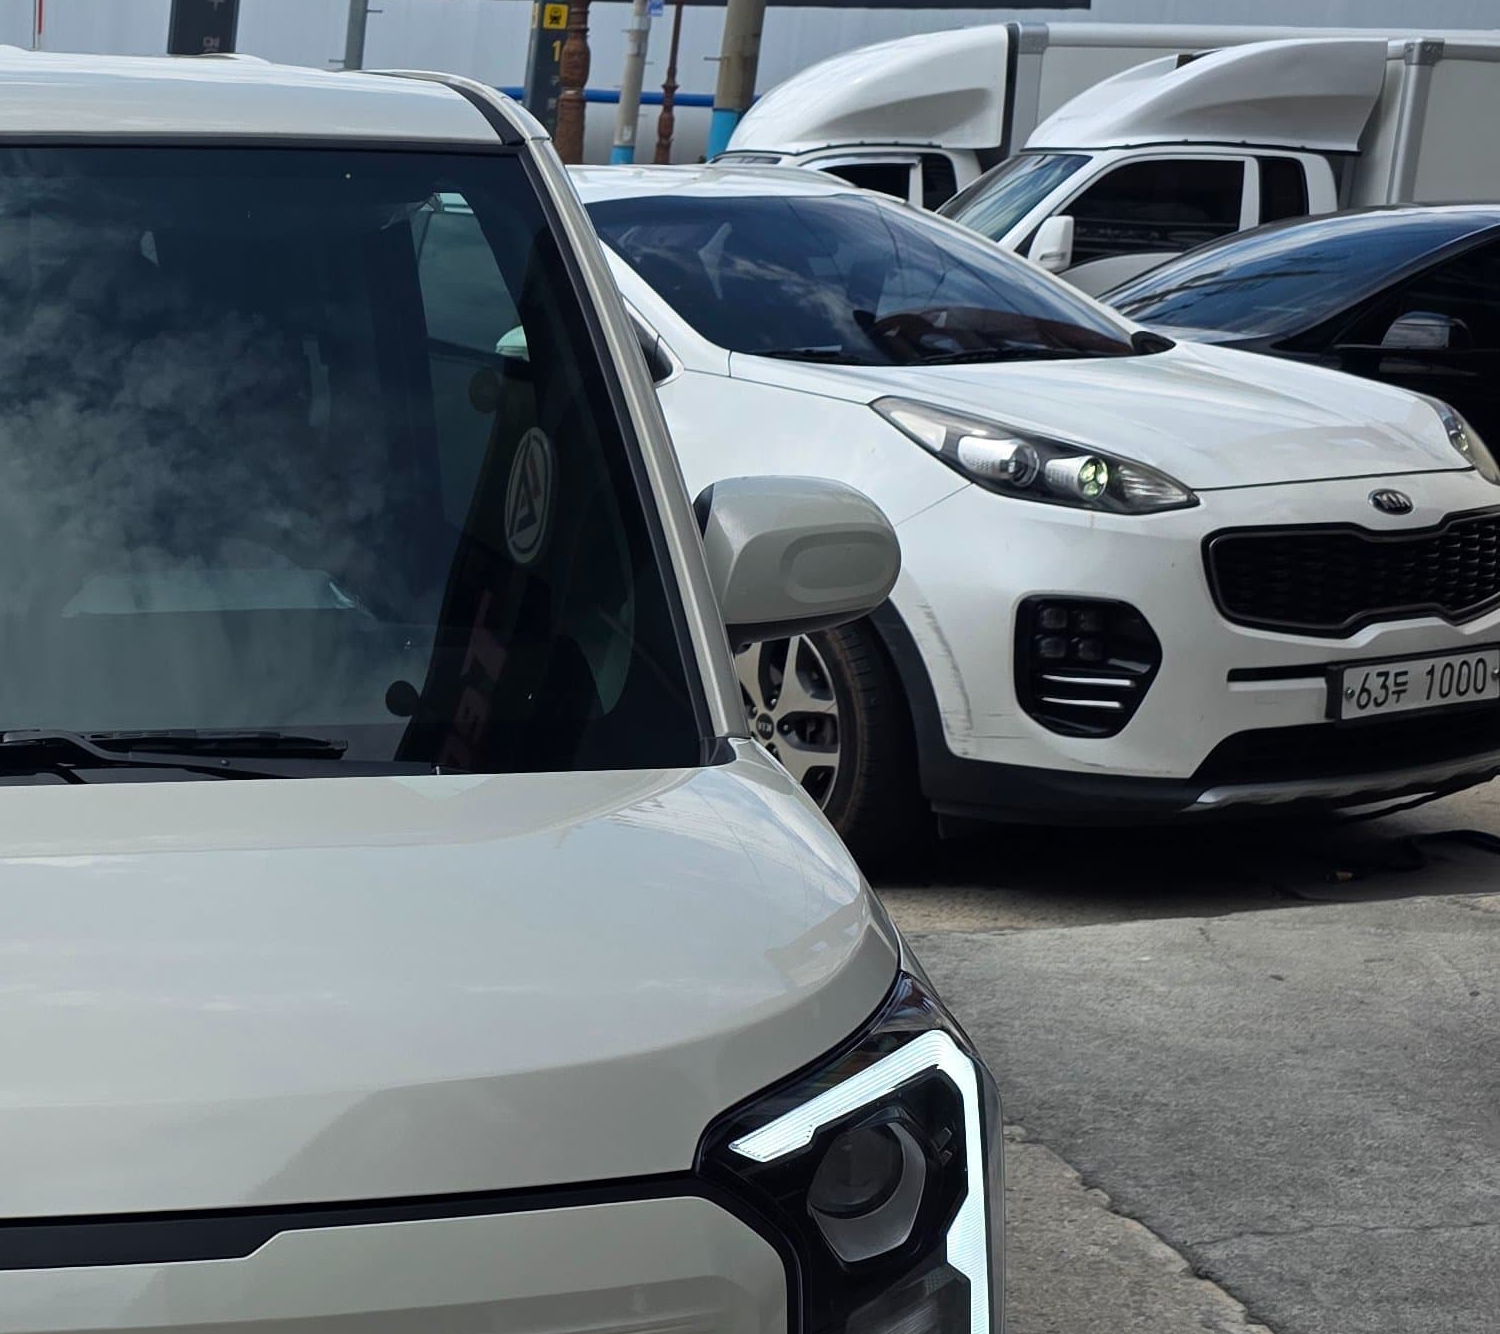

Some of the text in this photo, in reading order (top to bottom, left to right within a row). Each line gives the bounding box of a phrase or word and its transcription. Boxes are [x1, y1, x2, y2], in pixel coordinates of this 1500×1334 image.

[552, 40, 562, 63] 1
[1356, 657, 1488, 711] 63두 1000
